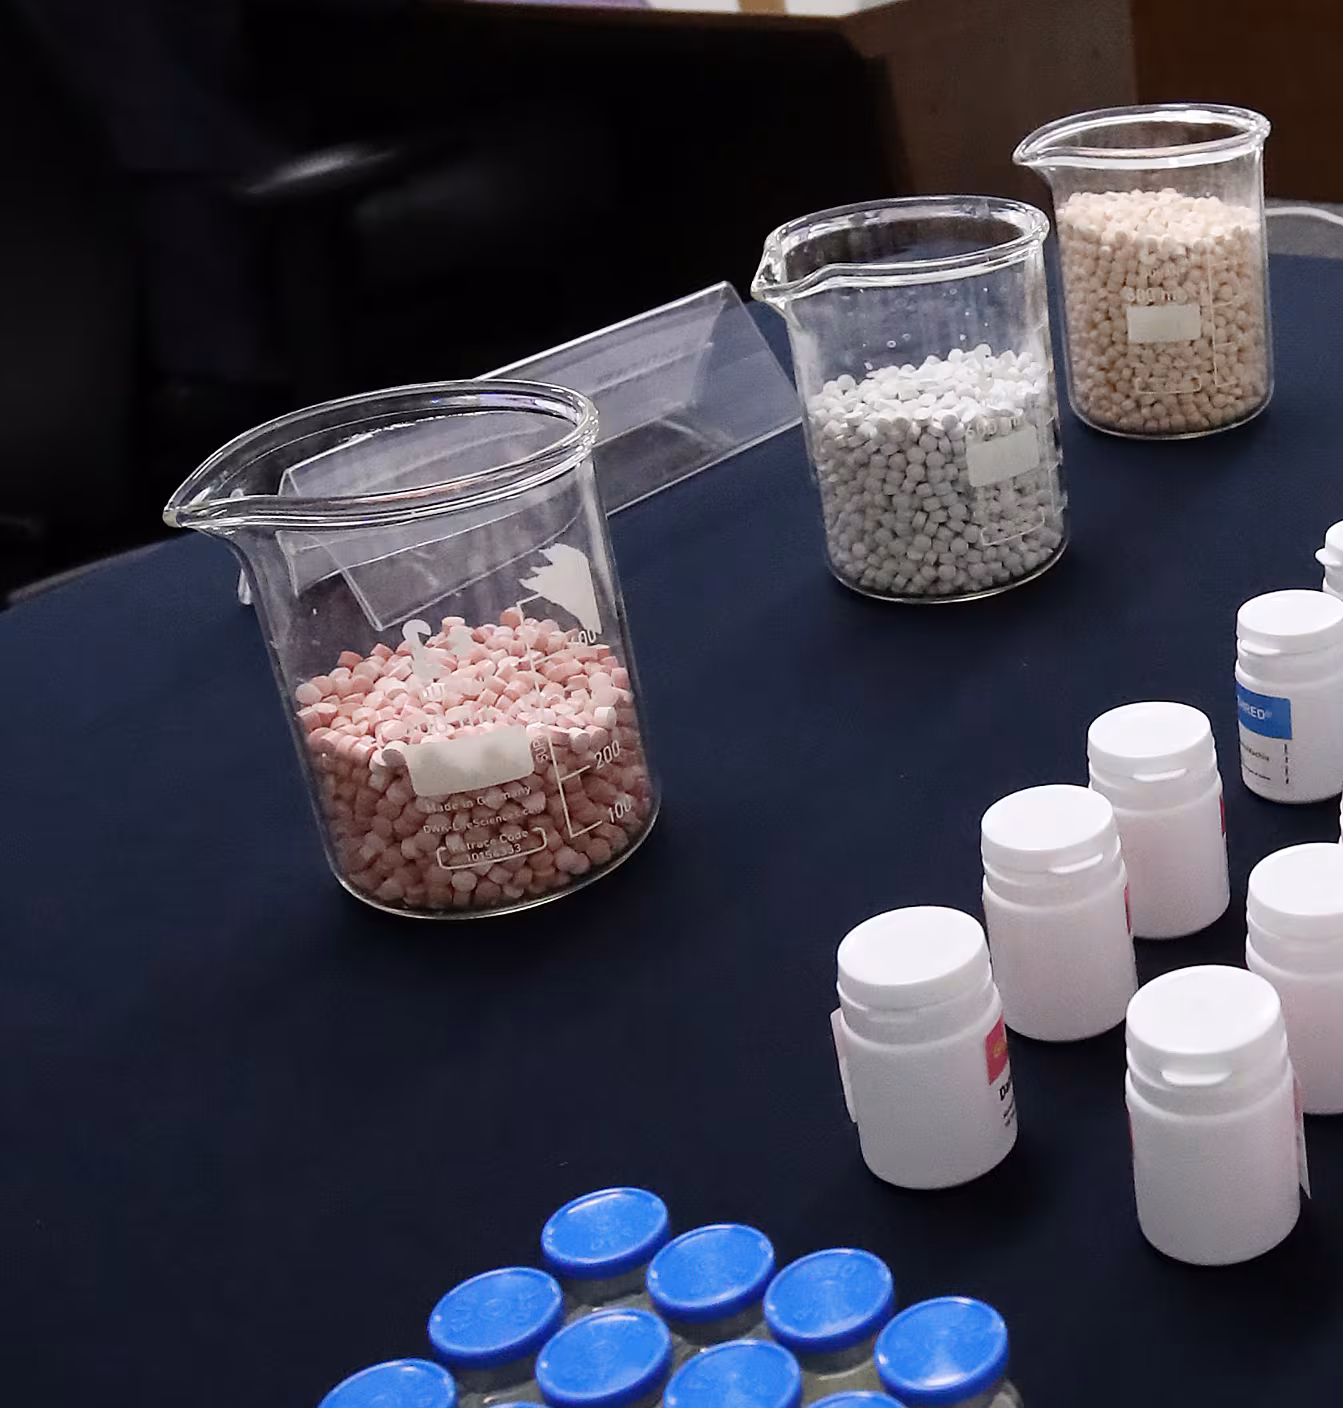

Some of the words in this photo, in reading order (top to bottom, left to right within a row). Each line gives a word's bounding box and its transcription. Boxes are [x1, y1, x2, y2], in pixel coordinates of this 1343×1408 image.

[594, 739, 620, 770] 200
[608, 796, 633, 825] 100
[499, 830, 529, 844] Code
